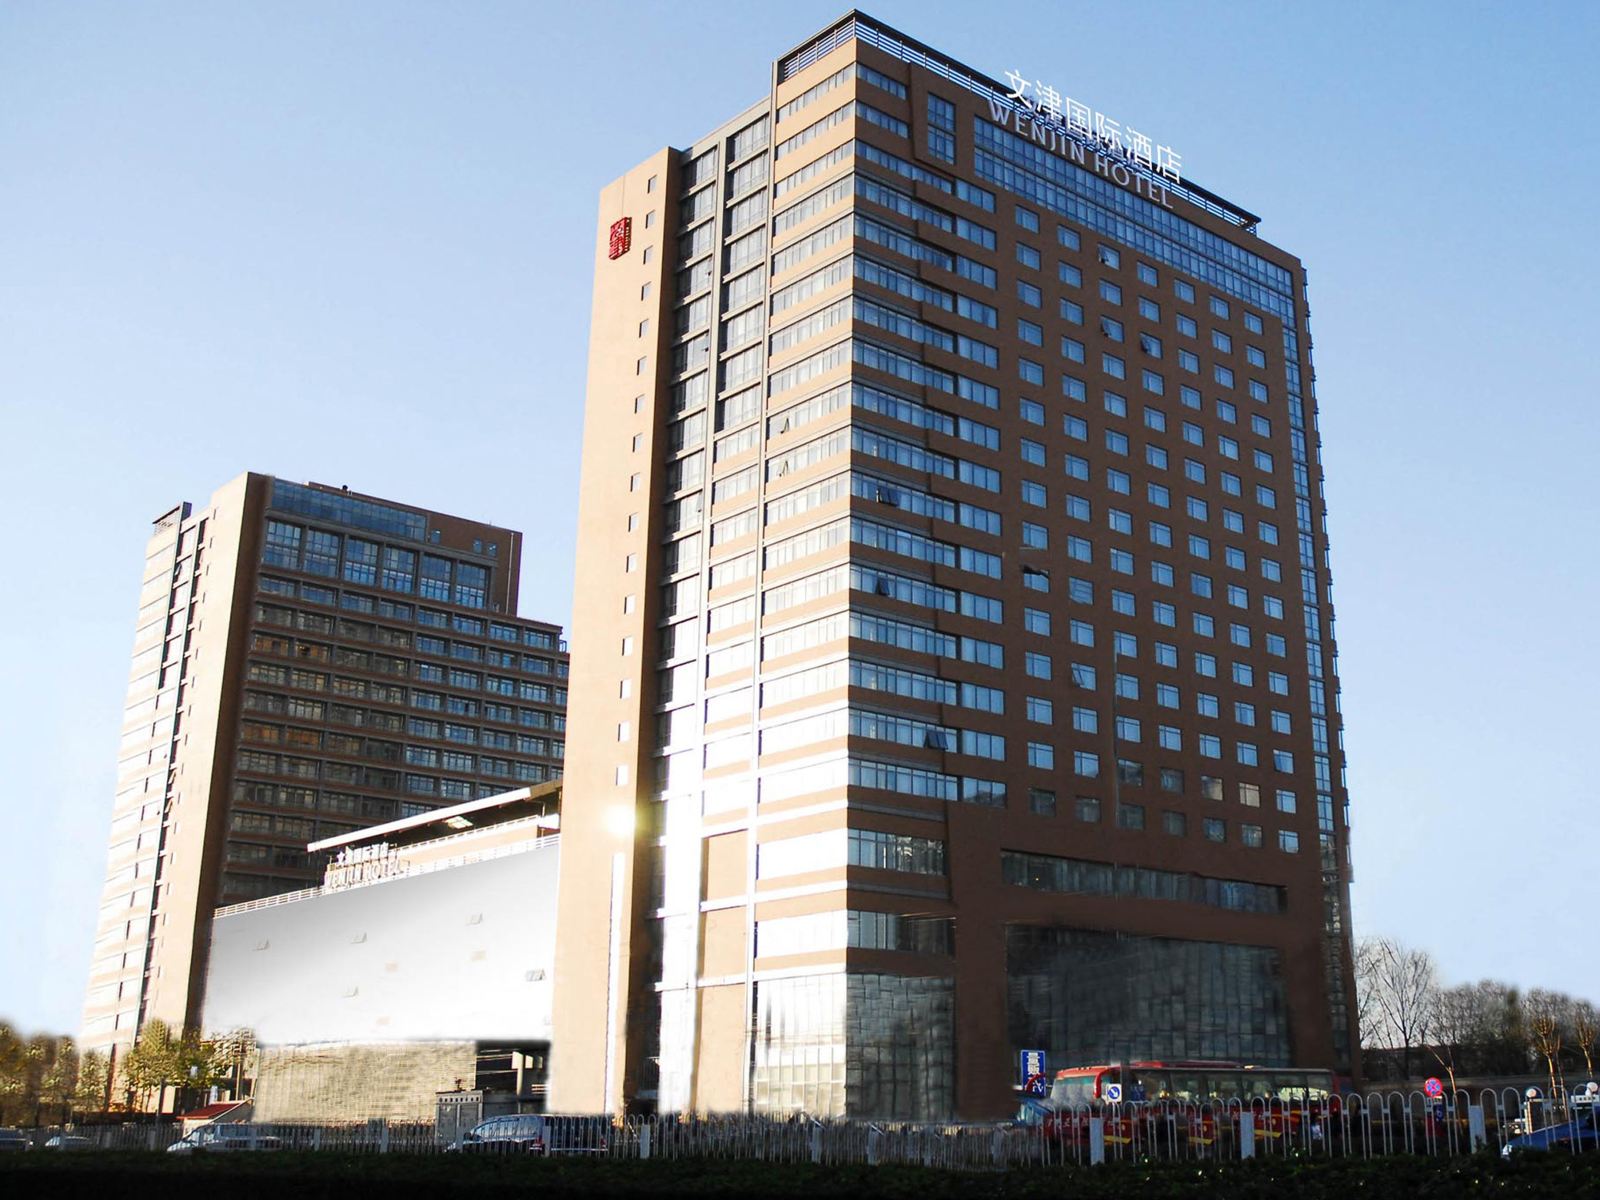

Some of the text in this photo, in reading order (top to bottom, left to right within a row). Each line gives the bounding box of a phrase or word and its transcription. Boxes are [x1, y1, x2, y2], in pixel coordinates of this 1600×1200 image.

[989, 100, 1174, 209] WENJIN HOTEL
[1004, 69, 1182, 184] 文津国际酒店
